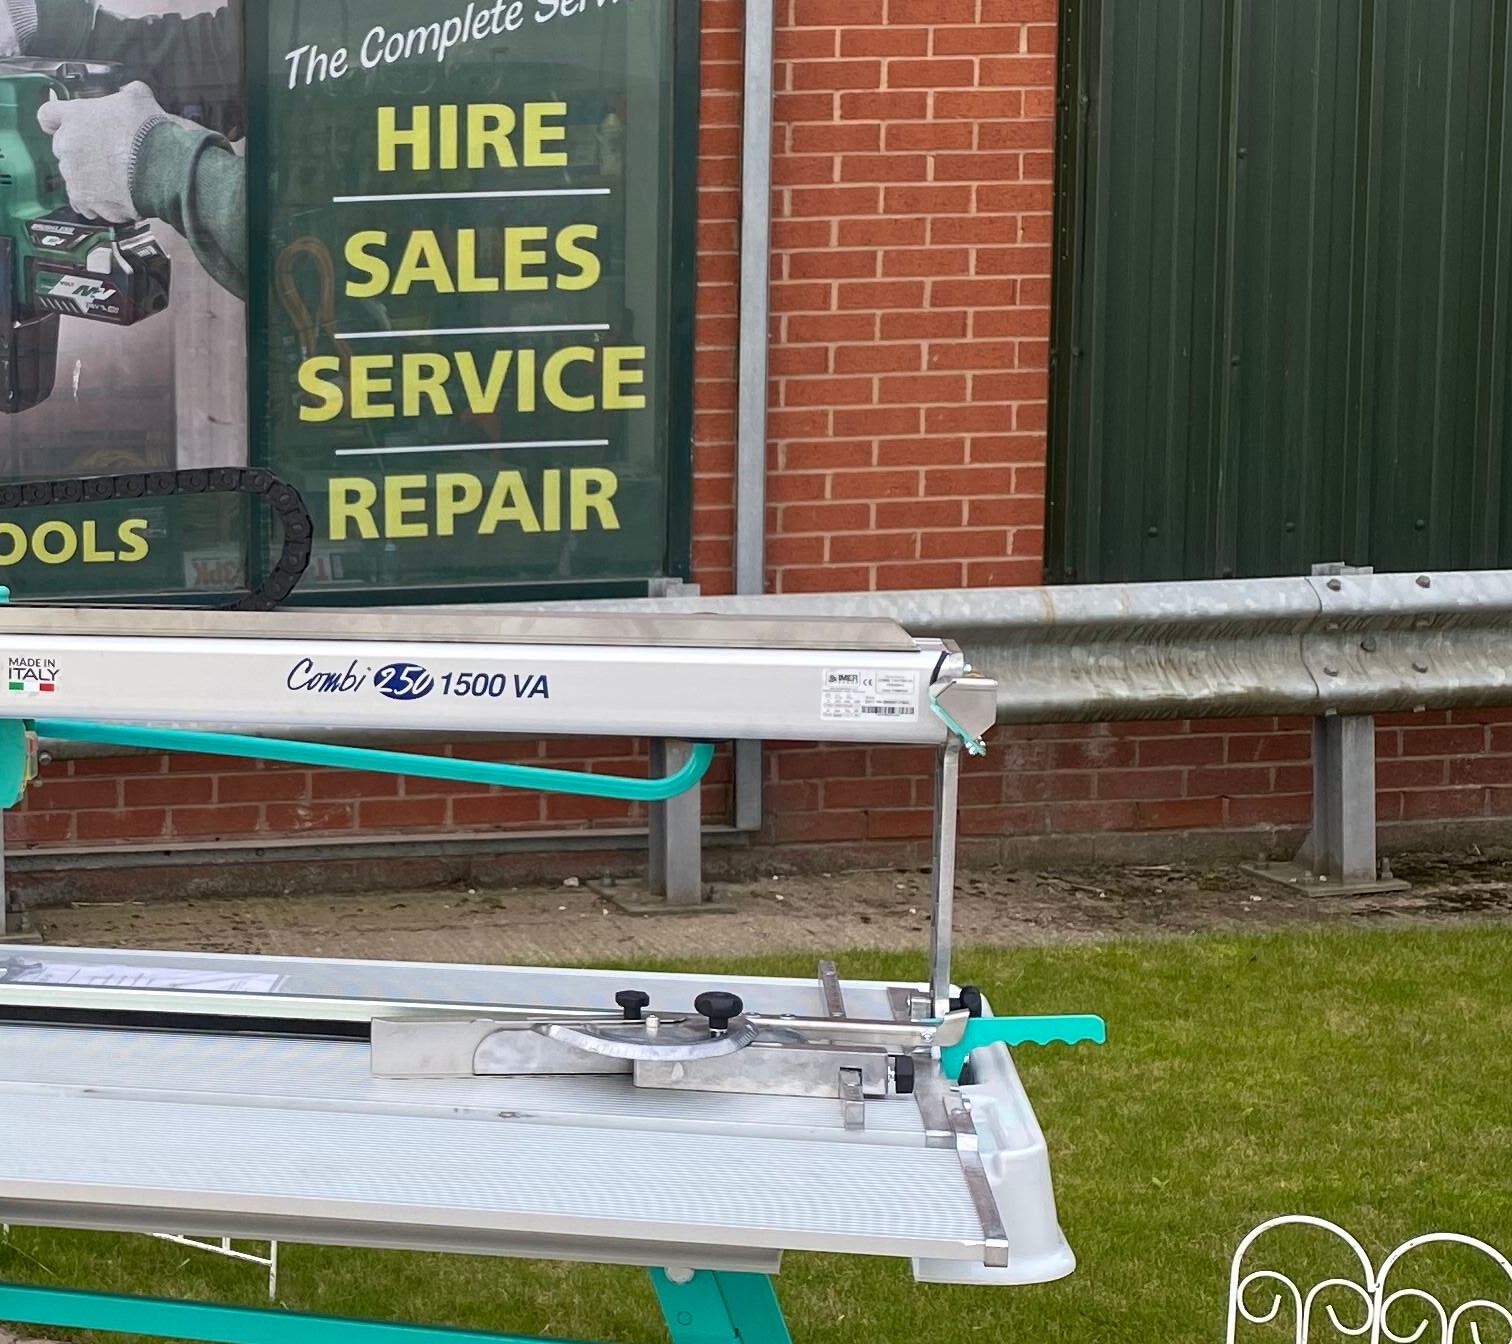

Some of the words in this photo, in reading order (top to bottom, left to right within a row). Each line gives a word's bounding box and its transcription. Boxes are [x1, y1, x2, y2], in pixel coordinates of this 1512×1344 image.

[285, 45, 349, 90] The
[377, 101, 568, 172] HIRE
[343, 223, 601, 298] SALES
[297, 345, 647, 423] SERVICE
[327, 467, 621, 541] REPAIR
[8, 657, 41, 668] MADE
[44, 659, 56, 668] IN
[8, 667, 60, 681] ITALY
[287, 657, 372, 693] Combi
[379, 666, 434, 695] 250
[441, 671, 506, 697] 1500
[513, 674, 550, 699] VA
